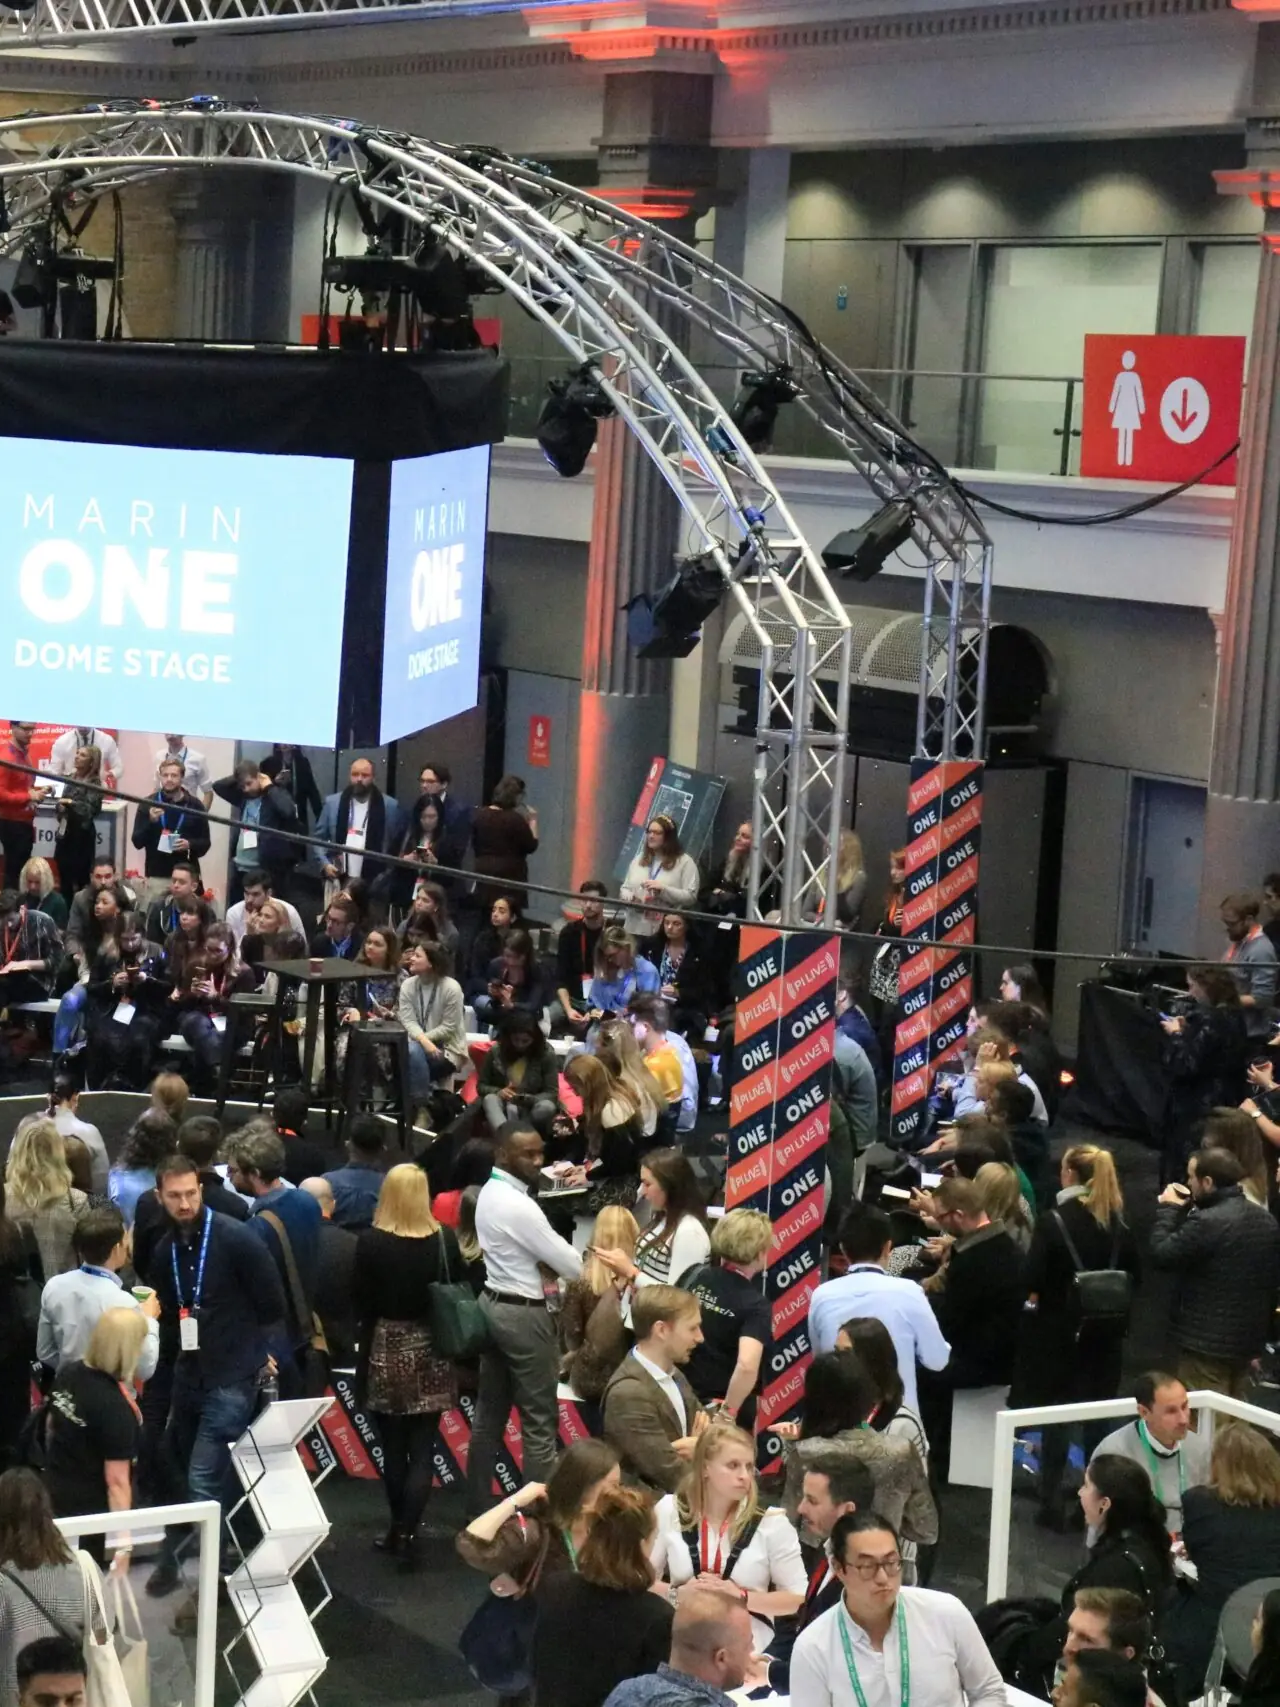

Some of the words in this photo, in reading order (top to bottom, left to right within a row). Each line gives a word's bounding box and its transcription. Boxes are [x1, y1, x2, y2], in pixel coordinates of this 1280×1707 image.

[23, 493, 241, 543] MARIN
[414, 499, 466, 543] MARIN
[20, 539, 239, 635] ONE
[410, 542, 465, 632] ONE
[15, 638, 113, 674] DOME
[124, 648, 232, 683] STAGE
[408, 651, 433, 680] DOME
[433, 638, 460, 673] STAGE
[950, 781, 978, 807] ONE
[914, 810, 937, 834] ONE
[946, 841, 974, 868] ONE
[910, 871, 933, 895] ONE
[943, 901, 971, 928] ONE
[747, 957, 777, 988] ONE
[805, 960, 827, 983] LIVE
[940, 962, 967, 989] ONE
[904, 992, 927, 1015] ONE
[791, 1001, 830, 1039] ONE
[936, 1022, 963, 1049] ONE
[741, 1041, 772, 1071] ONE
[800, 1043, 822, 1067] LIVE
[901, 1052, 924, 1075] ONE
[786, 1085, 824, 1122] ONE
[737, 1124, 767, 1154] ONE
[795, 1126, 817, 1150] LIVE
[781, 1168, 819, 1206] ONE
[790, 1211, 812, 1234] LIVE
[776, 1250, 814, 1288] ONE
[785, 1293, 807, 1317] LIVE
[771, 1334, 809, 1371] ONE
[780, 1375, 802, 1399] LIVE
[337, 1381, 355, 1409] ONE
[354, 1414, 376, 1442] ONE
[311, 1439, 331, 1468] ONE
[433, 1454, 455, 1484] ONE
[495, 1462, 517, 1492] ONE
